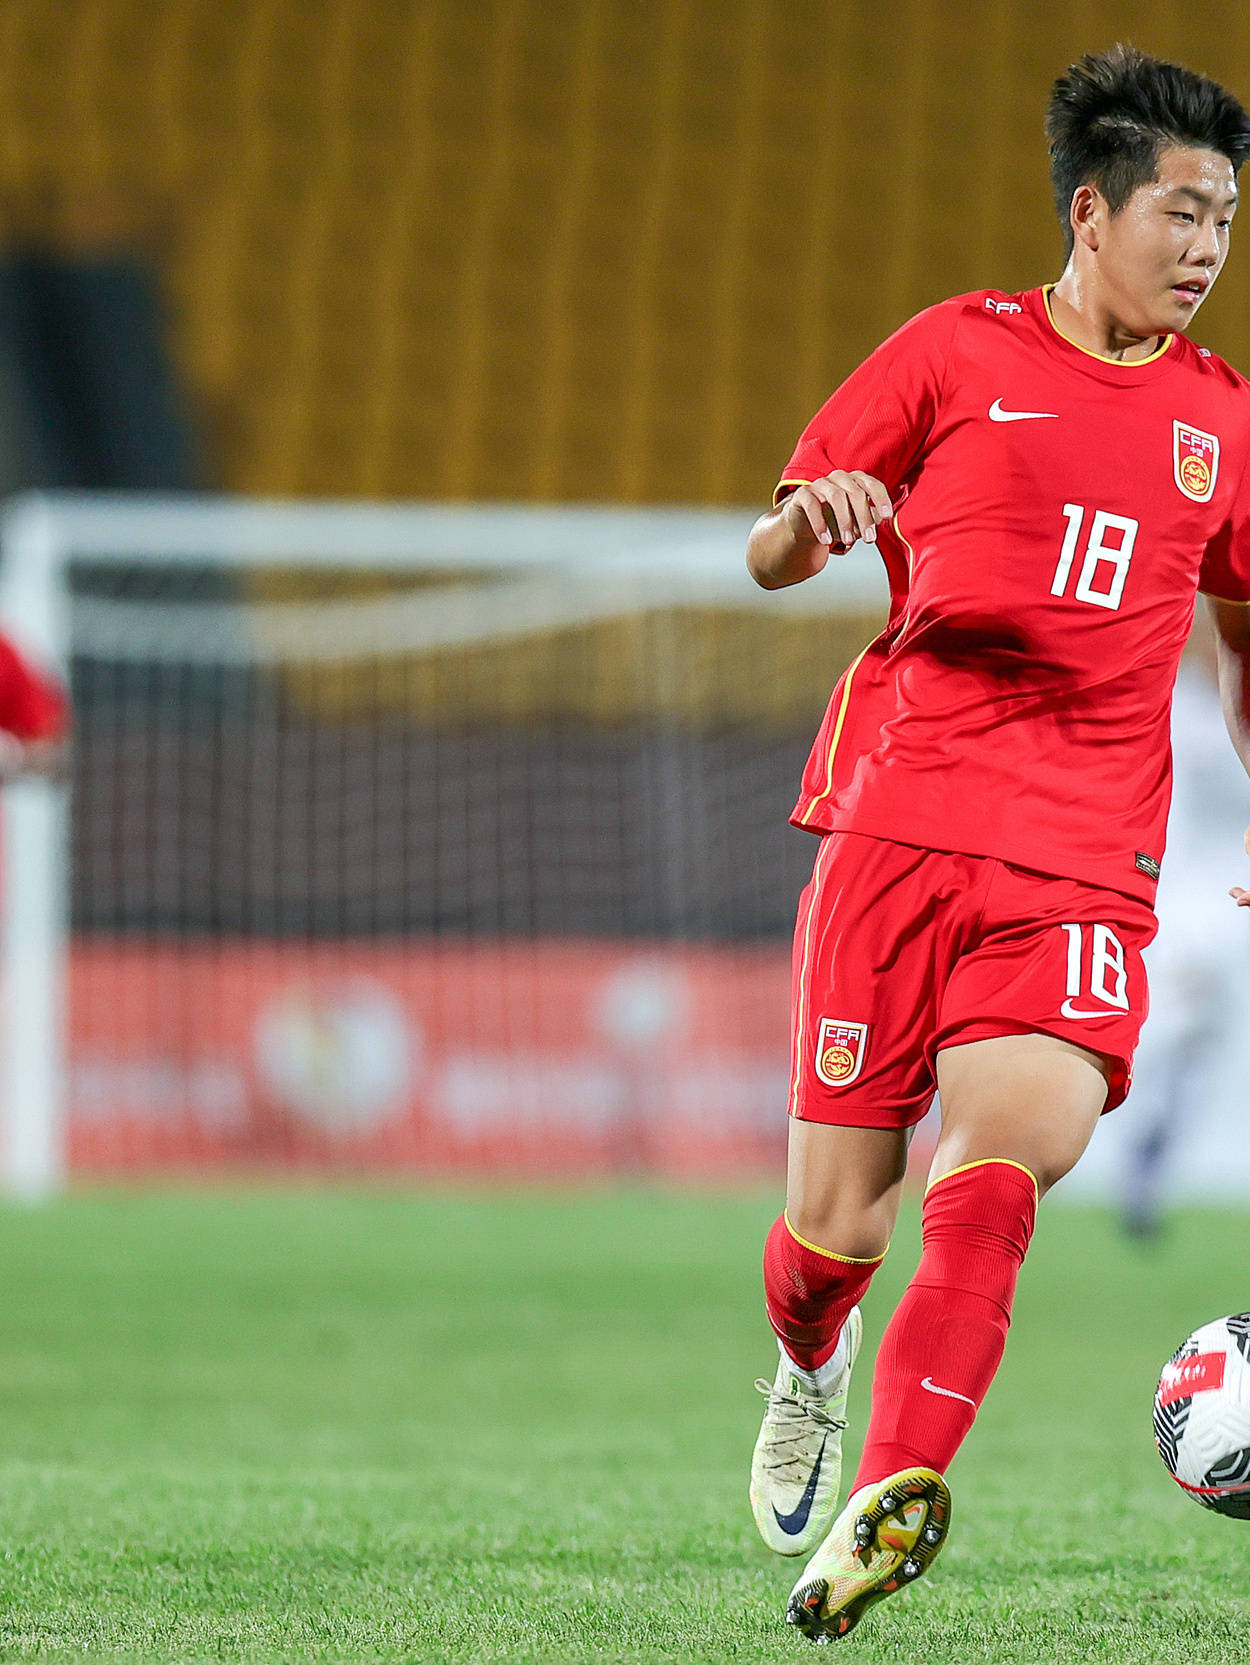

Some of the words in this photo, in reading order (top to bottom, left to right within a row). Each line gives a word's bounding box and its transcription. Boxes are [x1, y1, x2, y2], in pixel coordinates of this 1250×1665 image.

[985, 297, 1022, 314] CFA
[1180, 430, 1213, 453] CFA
[1050, 503, 1139, 611] 18
[1061, 923, 1130, 1010] 18
[825, 1026, 860, 1041] CFA
